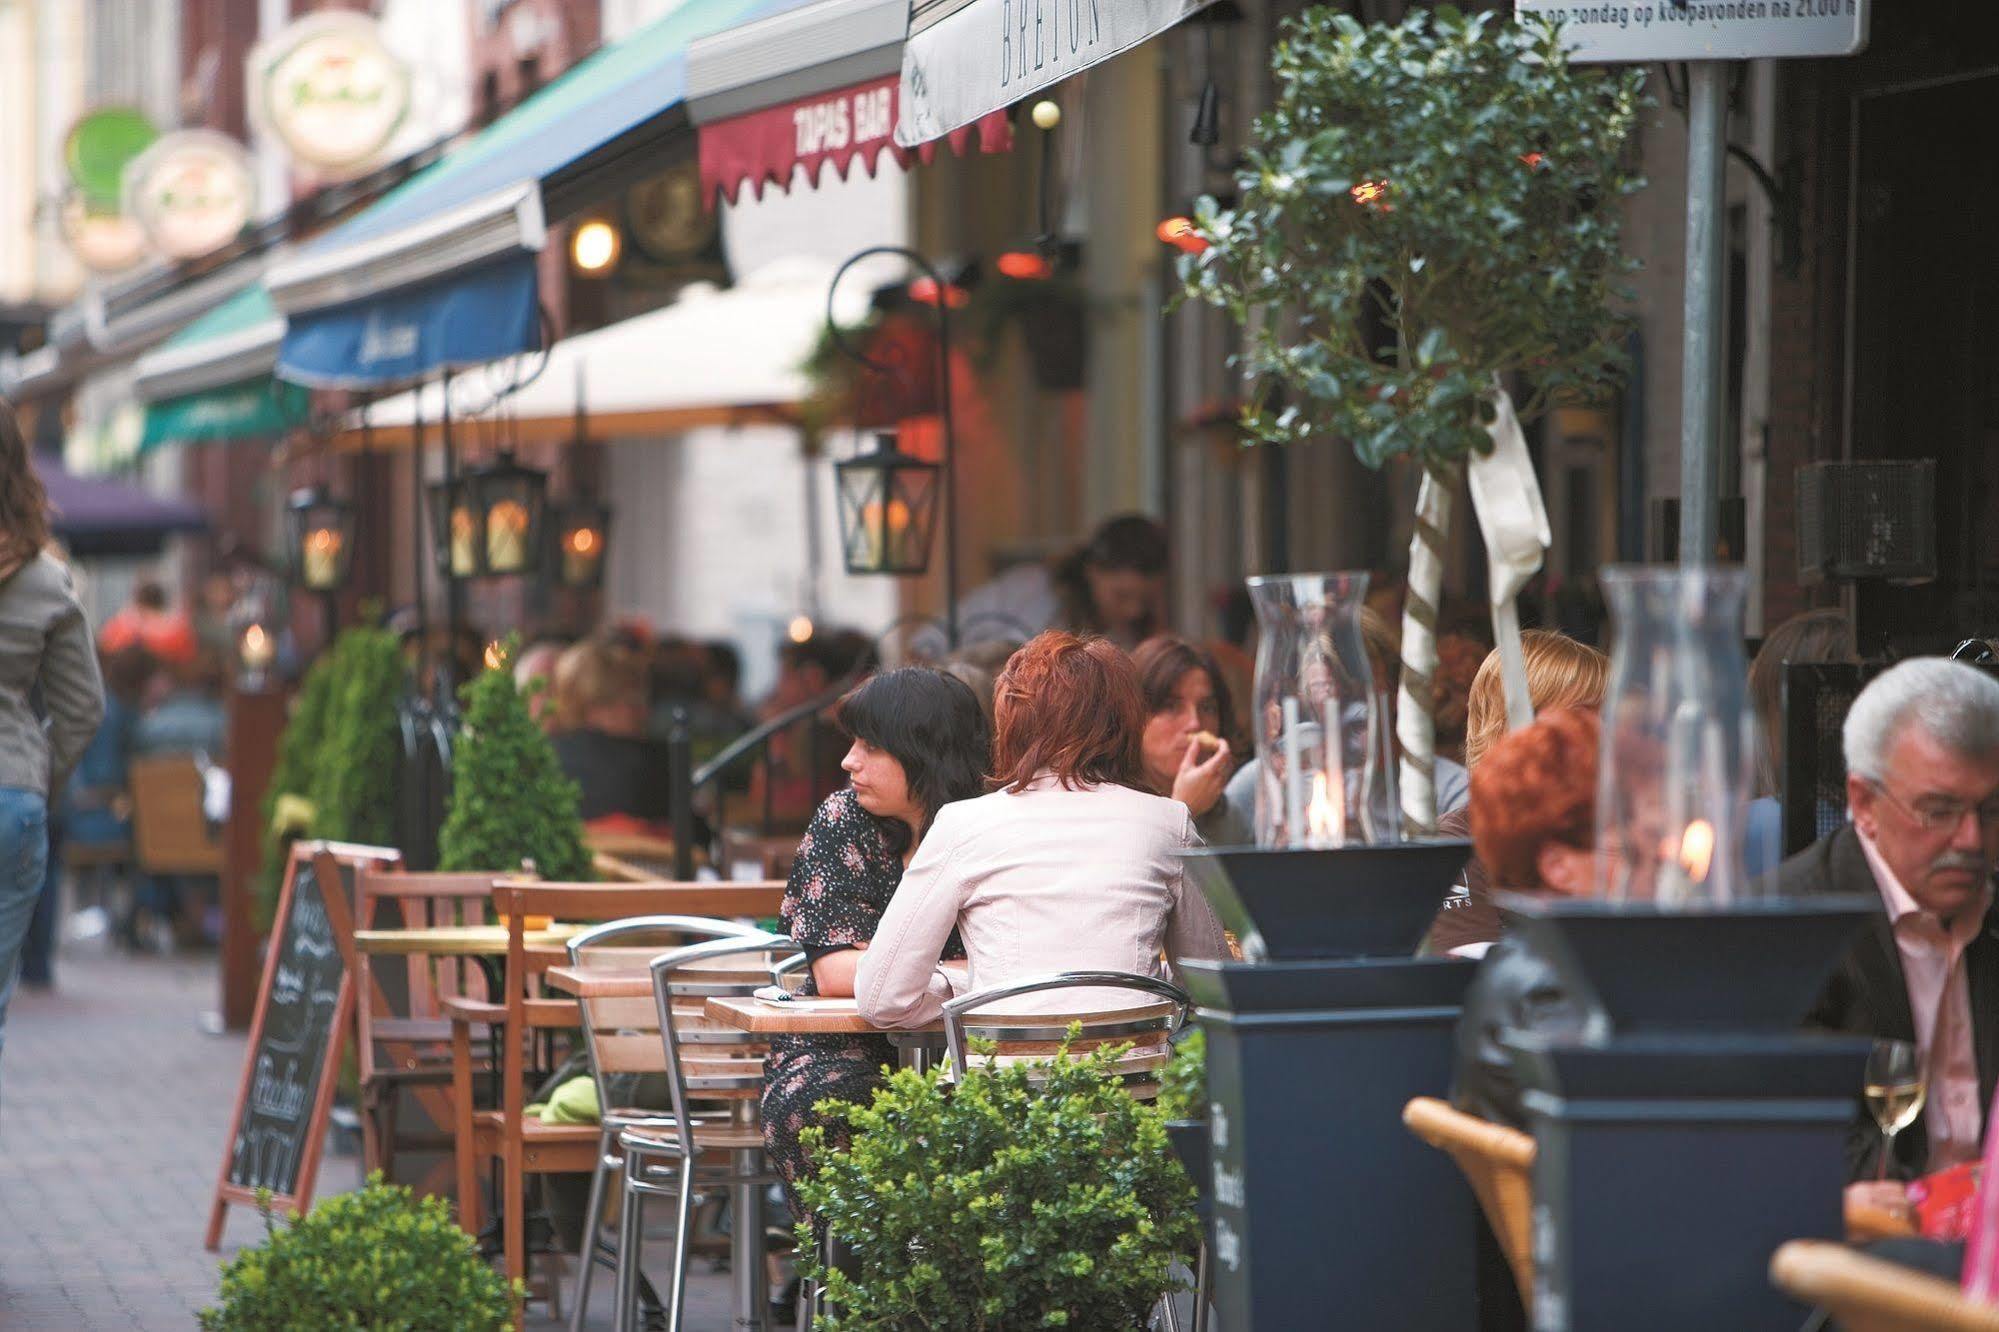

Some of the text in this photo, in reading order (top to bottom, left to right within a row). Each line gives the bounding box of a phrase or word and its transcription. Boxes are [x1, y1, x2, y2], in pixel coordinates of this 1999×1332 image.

[1573, 4, 1629, 29] zondag
[1634, 6, 1654, 28] op
[1659, 0, 1767, 26] koopavonden
[1771, 2, 1791, 18] na
[793, 87, 892, 157] TAPAS BAR
